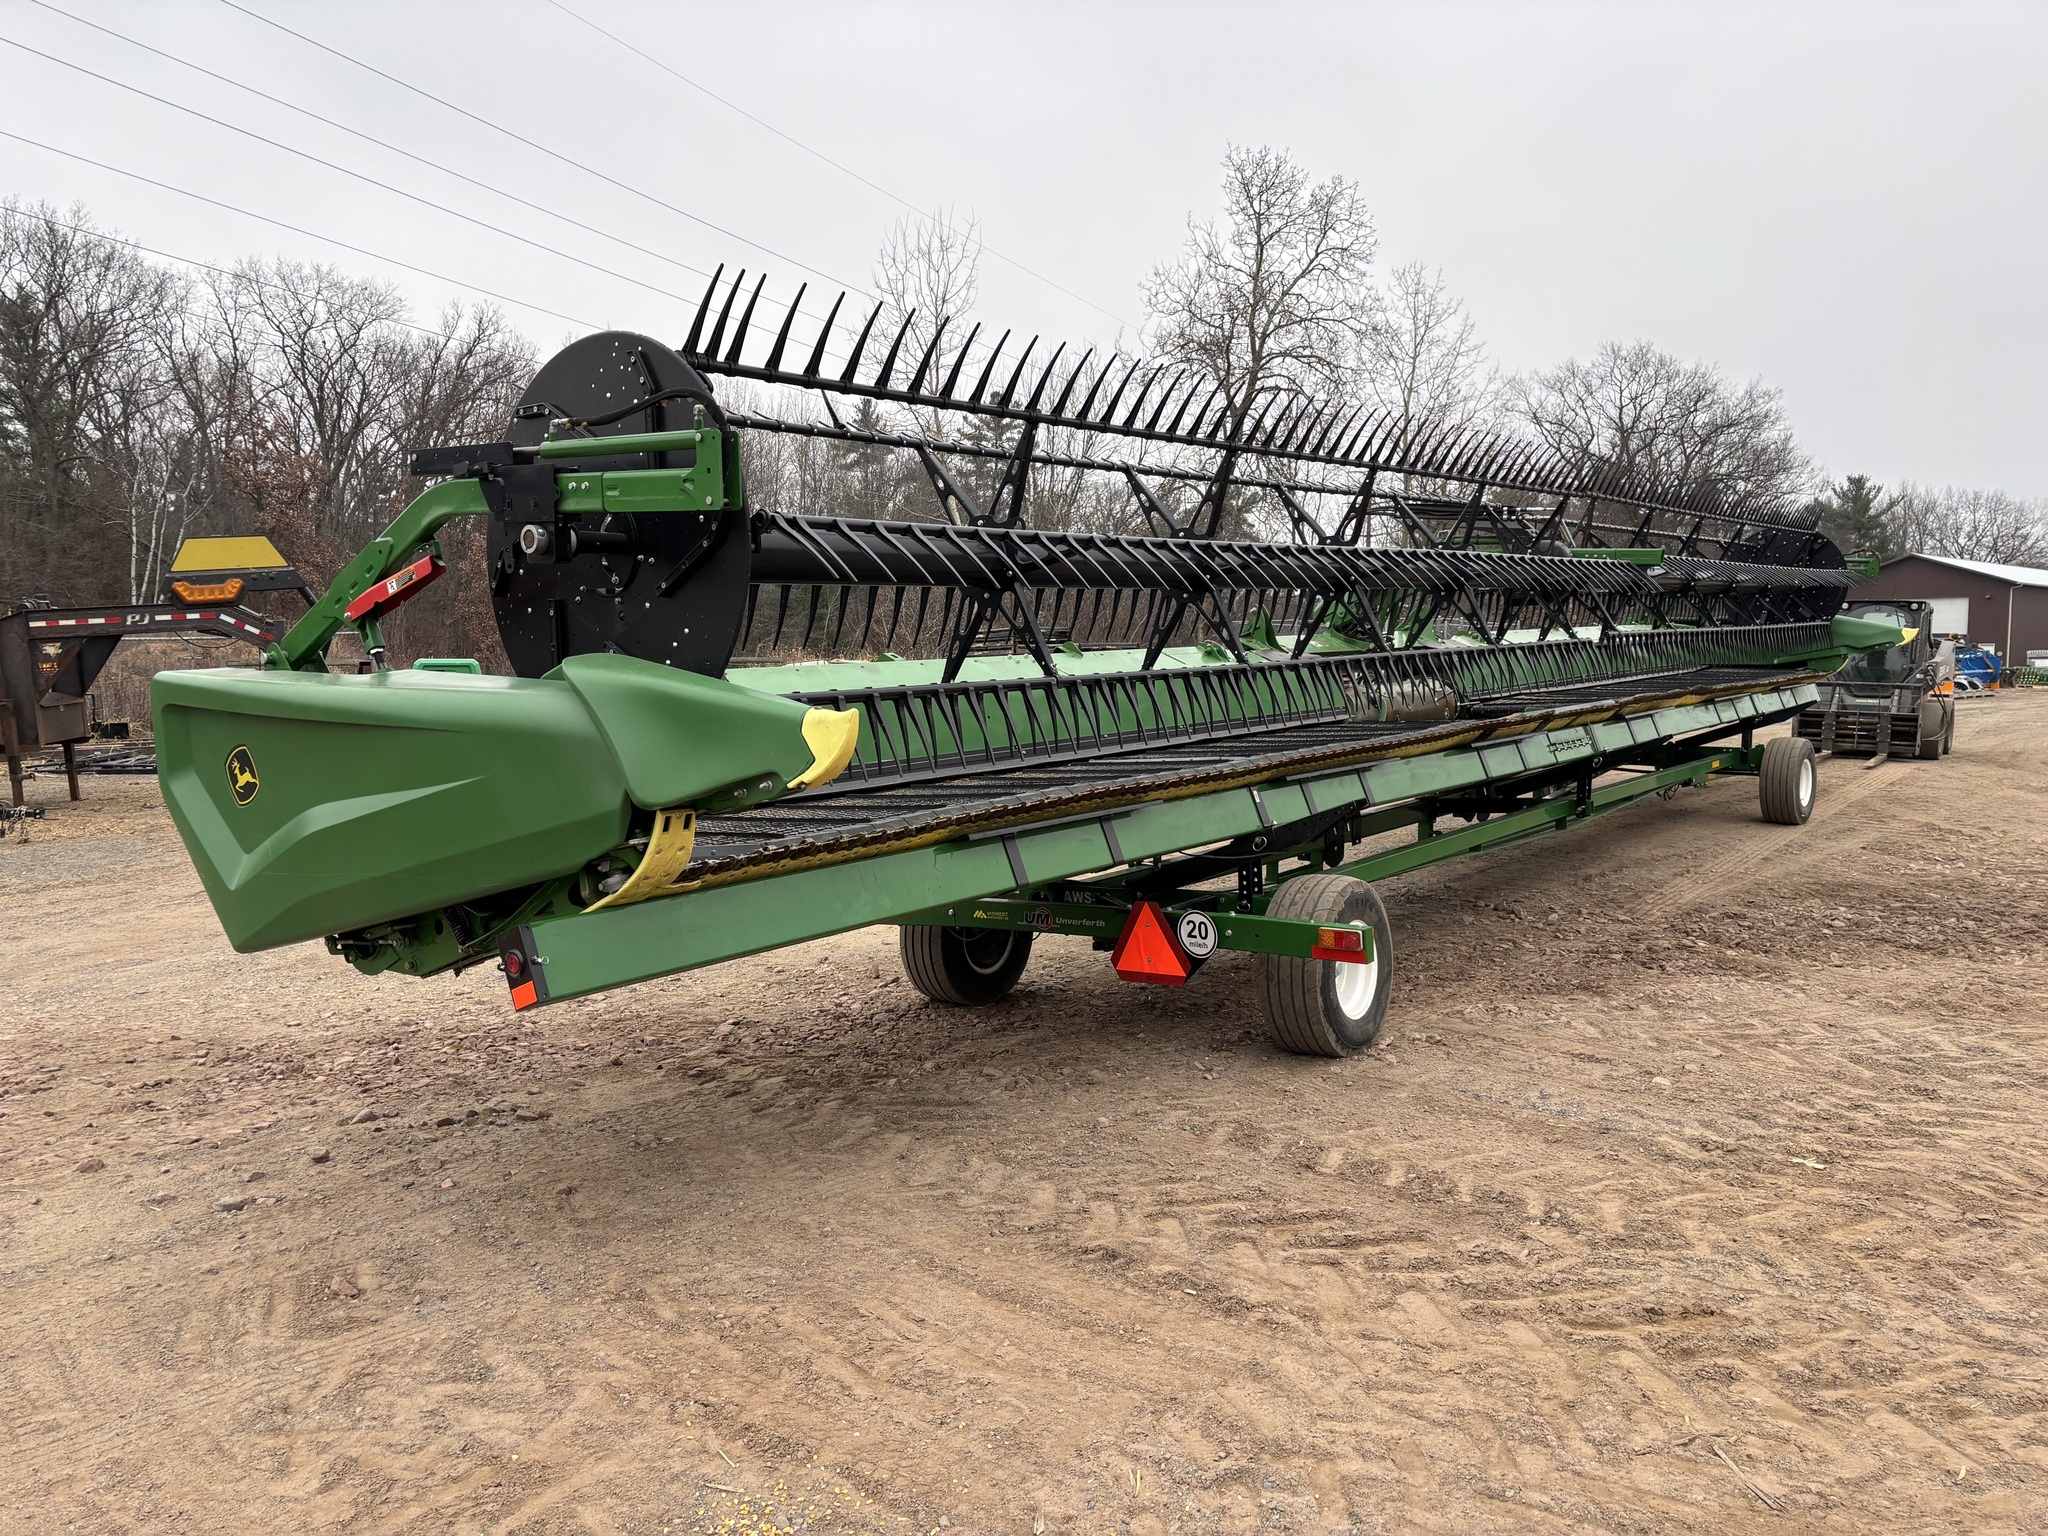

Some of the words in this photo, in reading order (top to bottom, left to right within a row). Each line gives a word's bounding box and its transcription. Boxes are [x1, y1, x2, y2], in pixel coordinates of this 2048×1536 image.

[125, 613, 150, 625] PJ
[1055, 917, 1106, 927] Unverferth
[1186, 919, 1209, 940] 20
